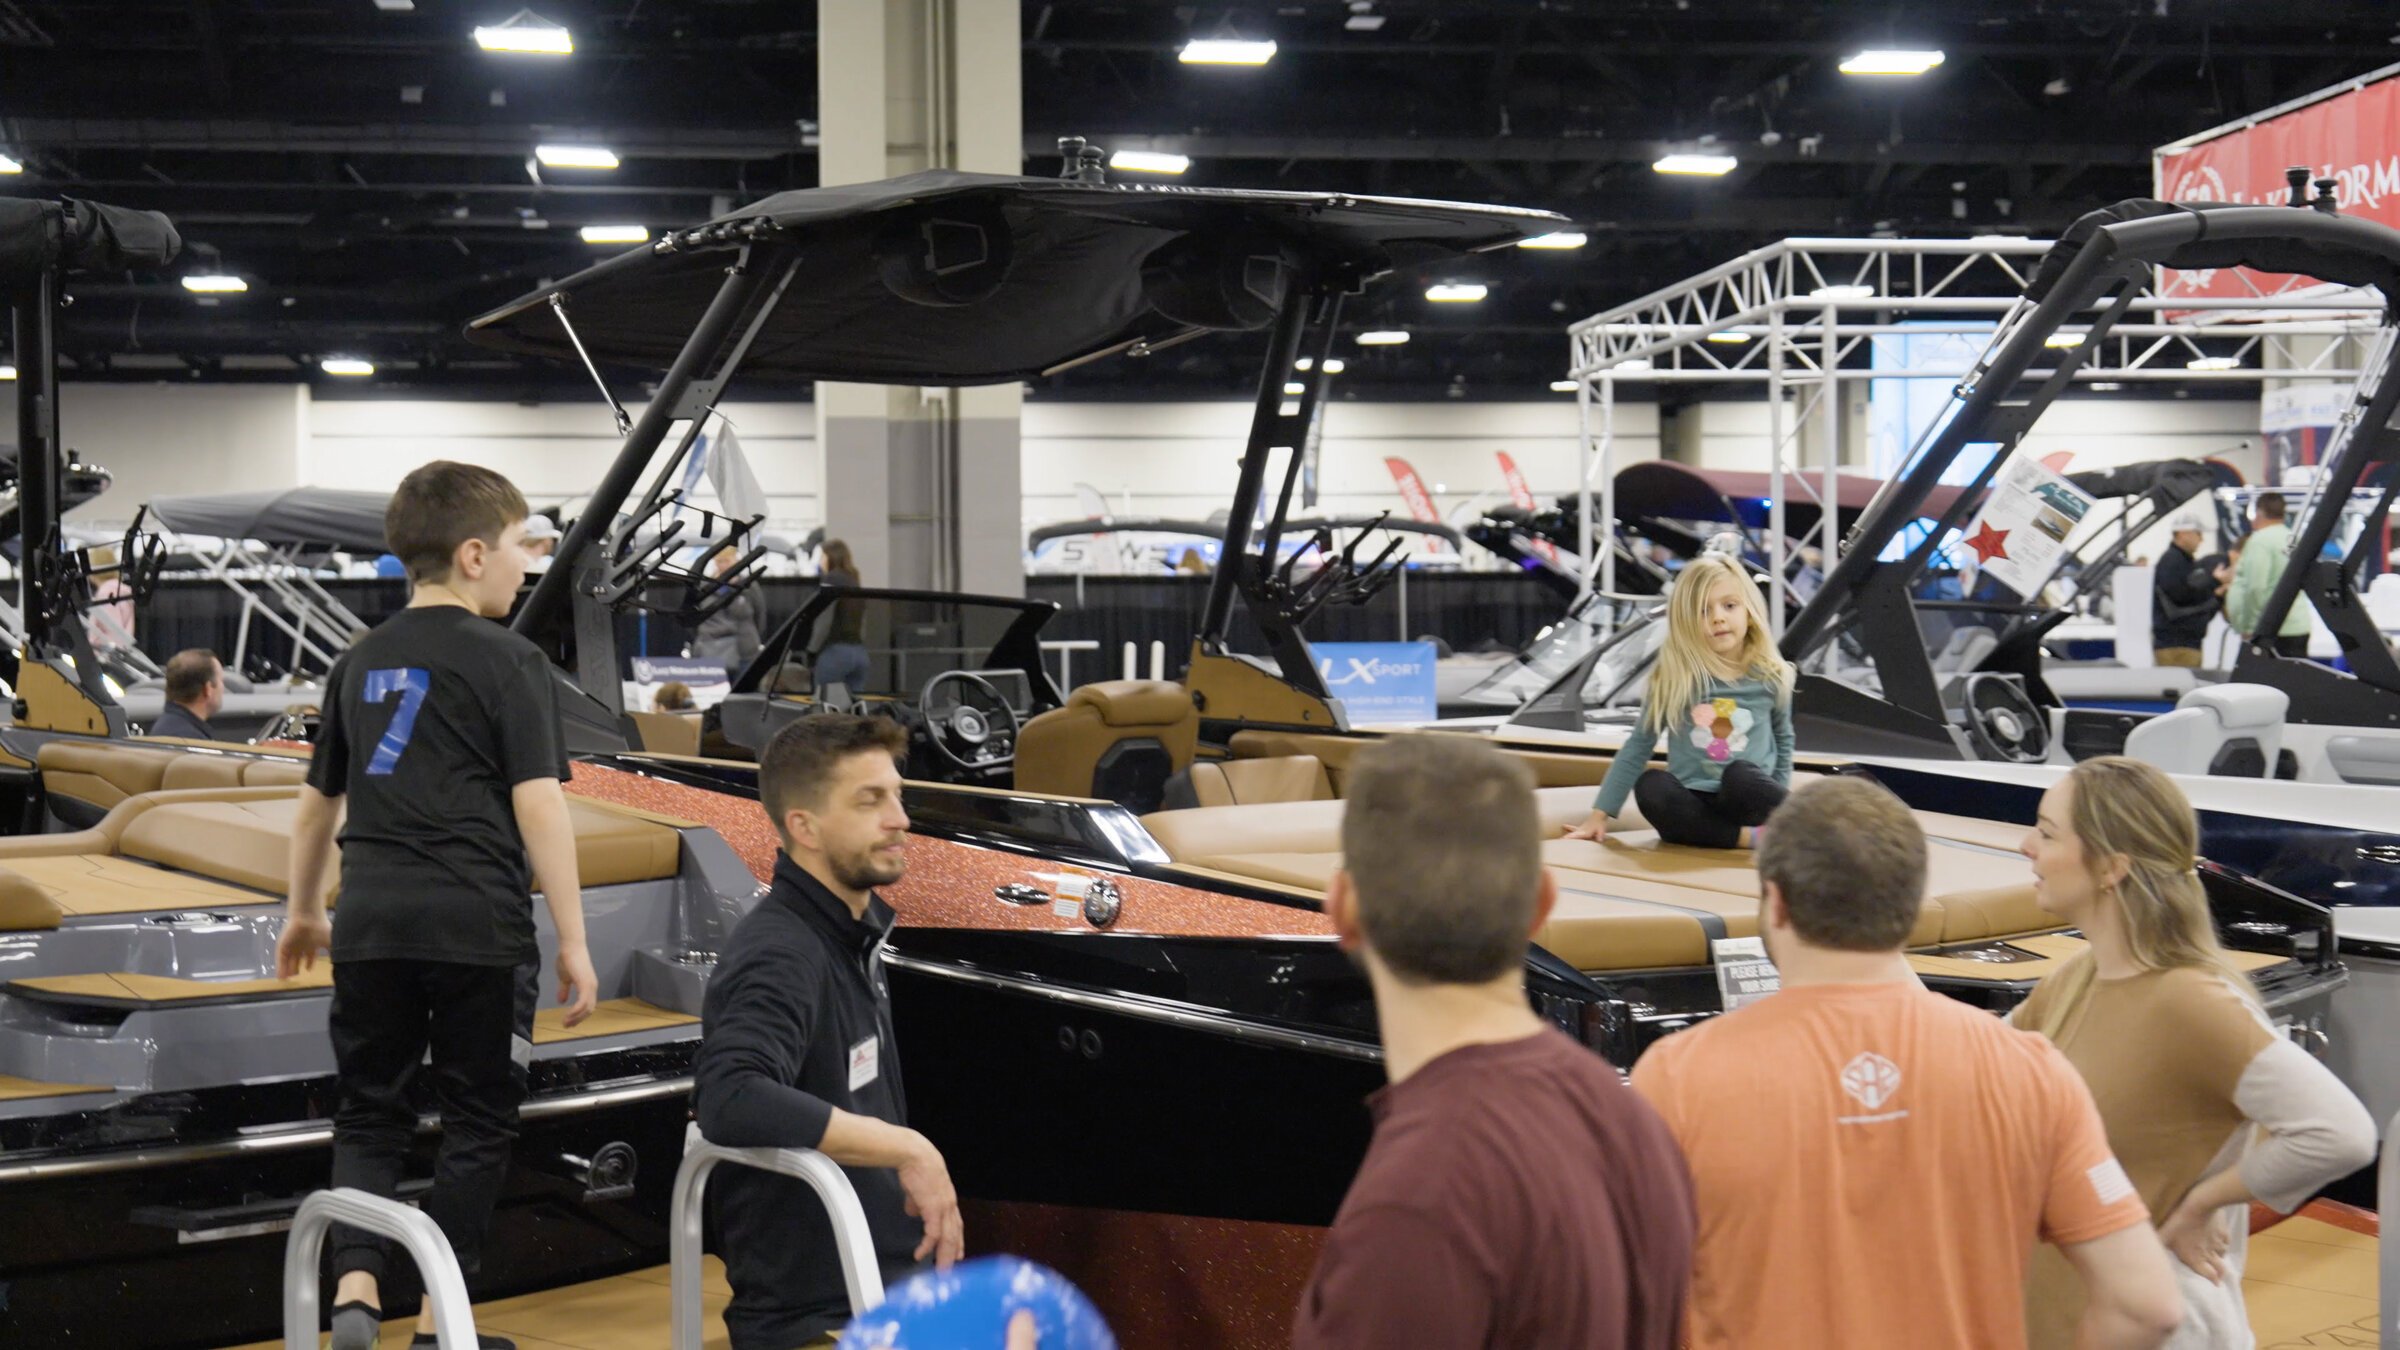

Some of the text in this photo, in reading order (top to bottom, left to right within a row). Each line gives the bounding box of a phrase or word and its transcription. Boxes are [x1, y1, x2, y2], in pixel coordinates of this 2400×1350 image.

[1372, 663, 1421, 677] SPORT
[363, 667, 429, 775] 7
[1730, 965, 1760, 979] PLEASE
